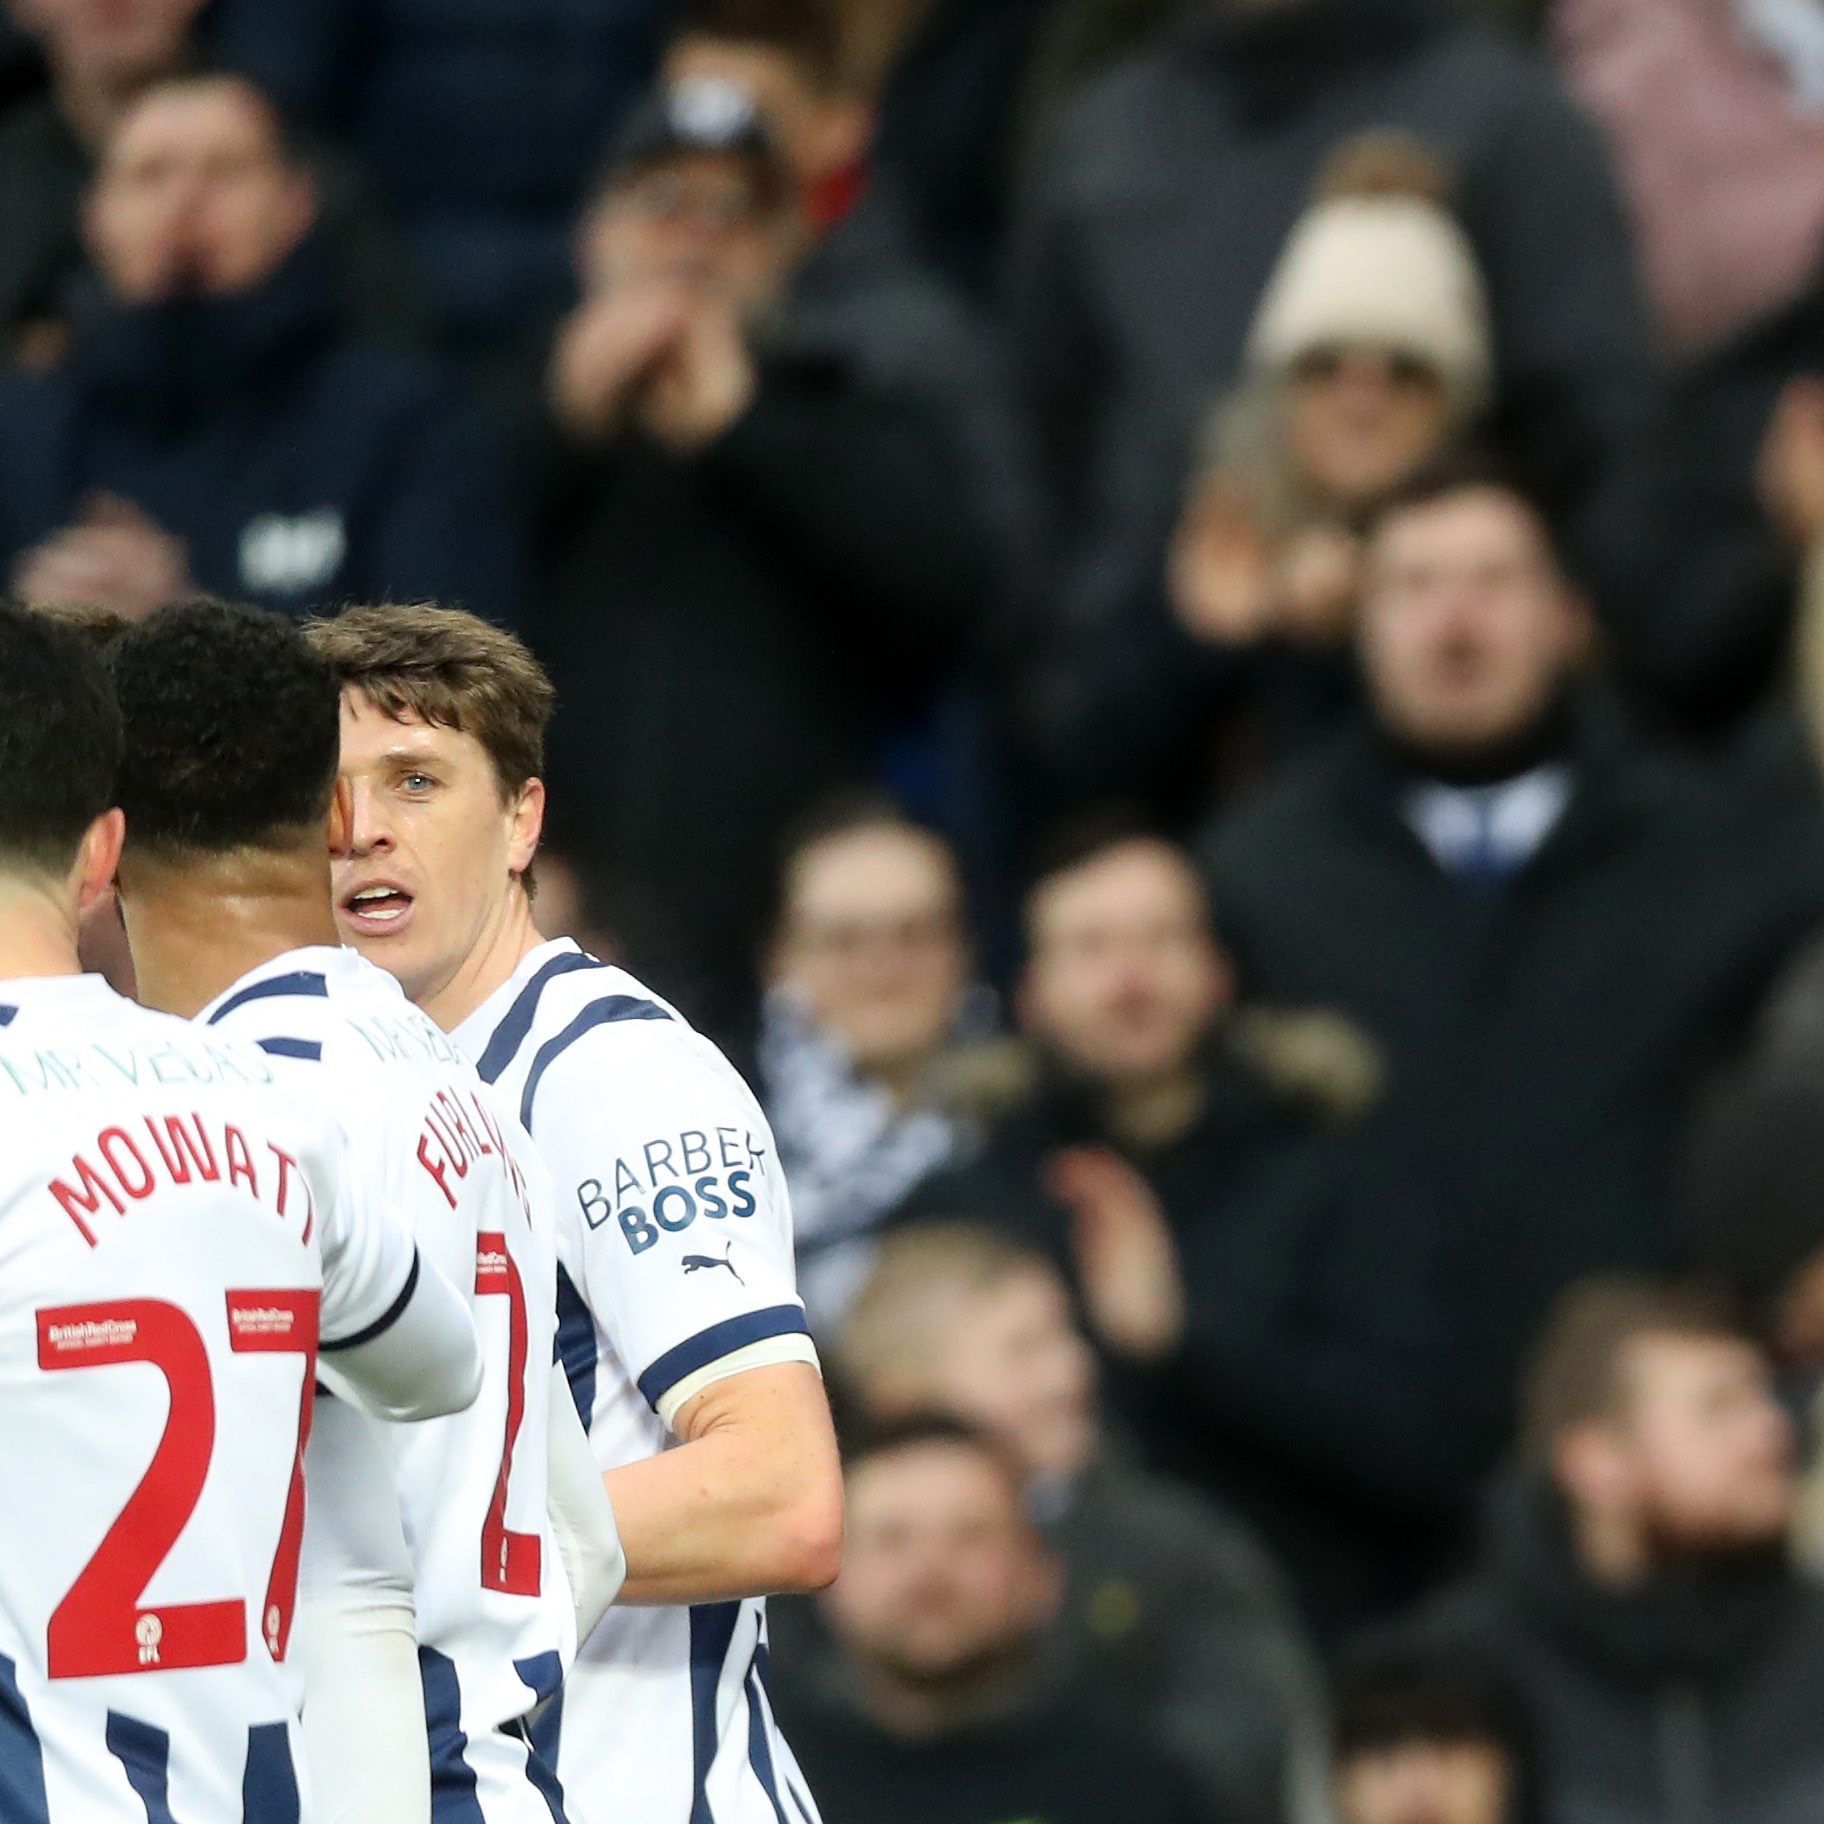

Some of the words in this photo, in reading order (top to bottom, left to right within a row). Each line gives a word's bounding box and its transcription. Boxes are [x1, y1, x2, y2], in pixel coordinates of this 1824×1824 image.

[577, 1126, 766, 1231] BARBER
[618, 1170, 757, 1256] BOSS
[35, 1287, 322, 1681] 27
